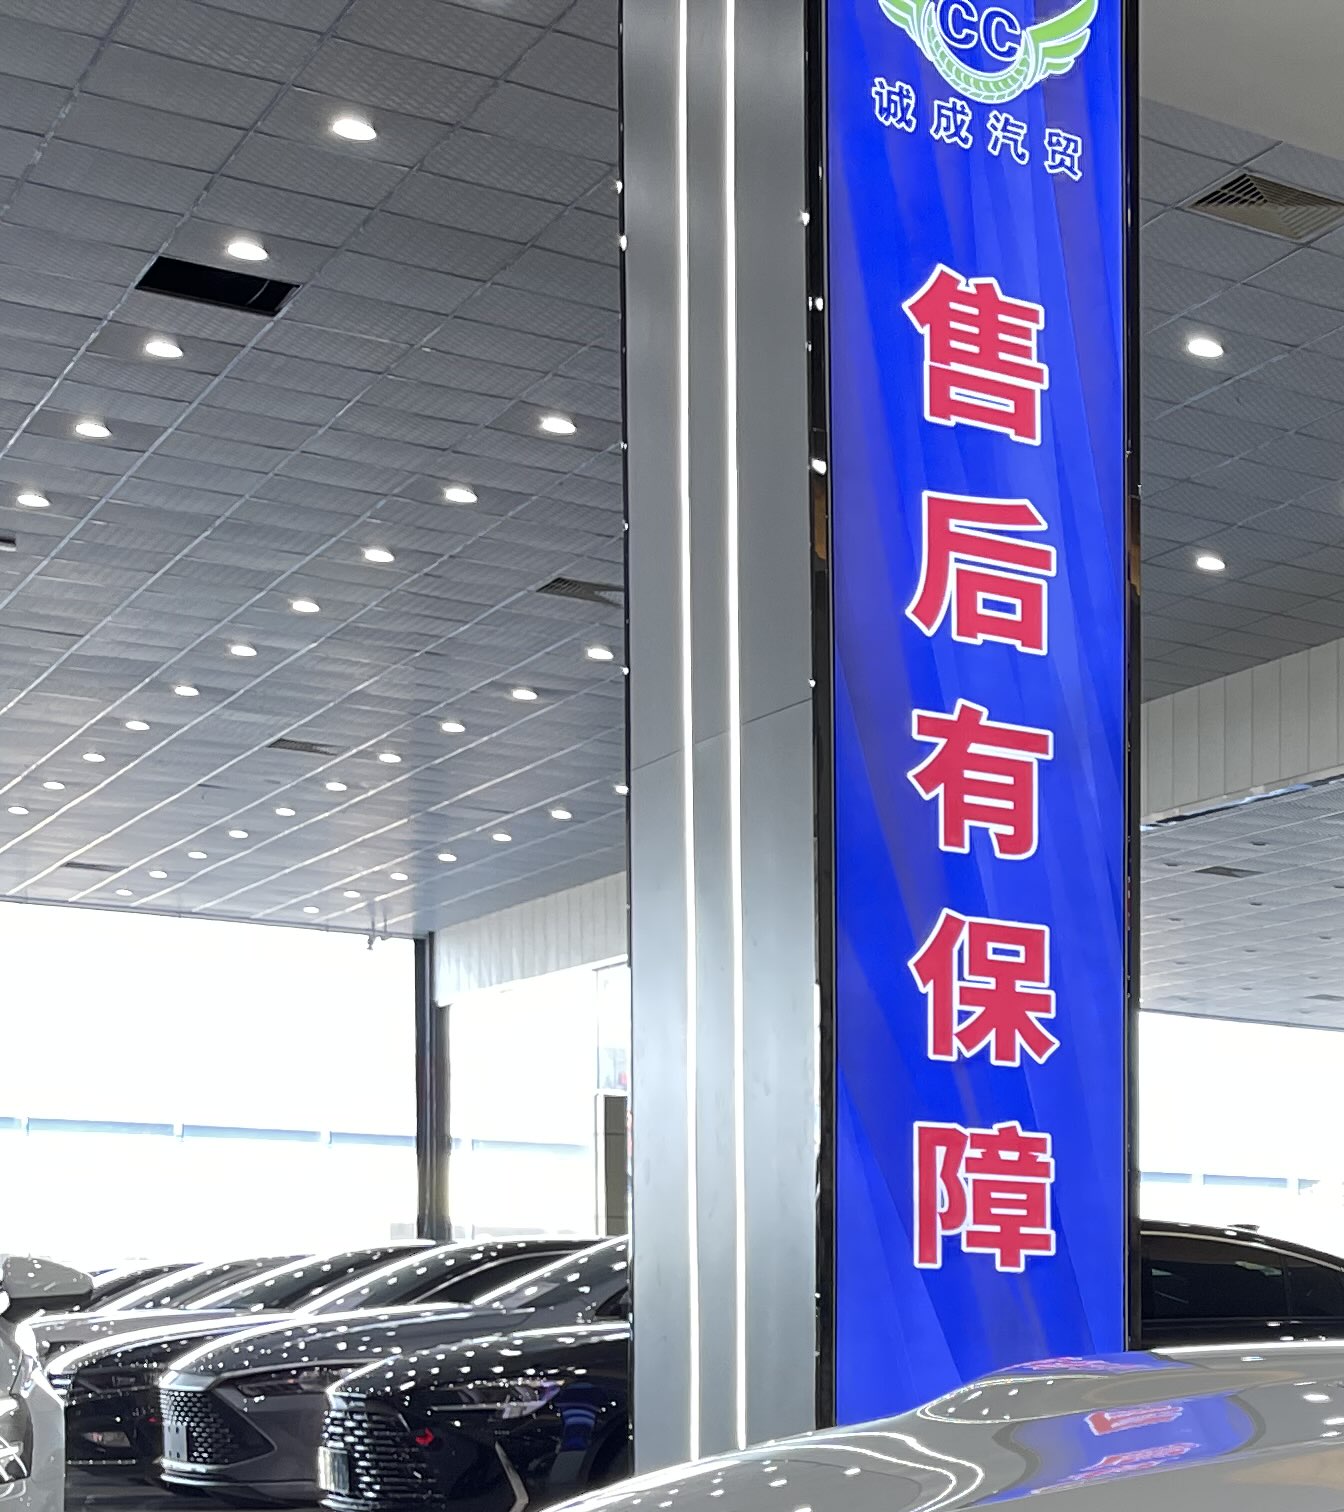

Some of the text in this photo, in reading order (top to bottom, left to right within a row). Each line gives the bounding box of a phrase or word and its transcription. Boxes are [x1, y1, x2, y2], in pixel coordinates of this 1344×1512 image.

[936, 0, 1023, 62] CC
[872, 76, 1083, 182] 诚成汽贸
[902, 263, 1061, 1273] 售后有保障
